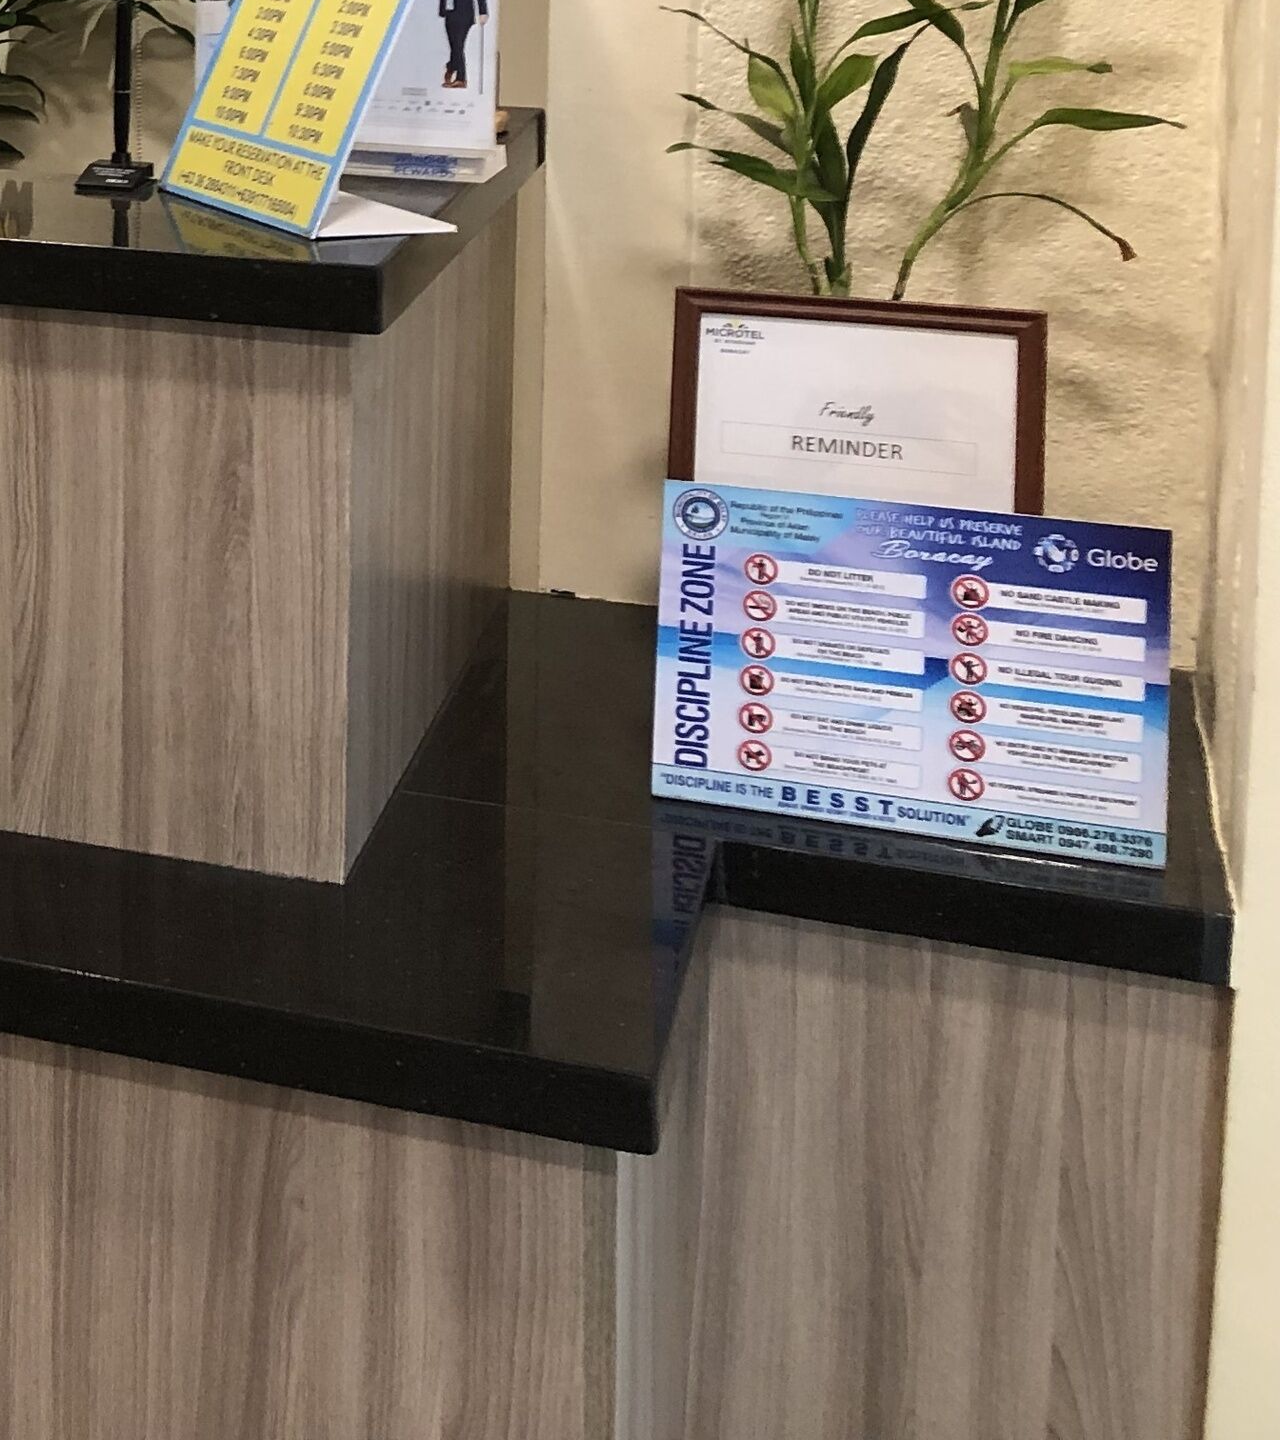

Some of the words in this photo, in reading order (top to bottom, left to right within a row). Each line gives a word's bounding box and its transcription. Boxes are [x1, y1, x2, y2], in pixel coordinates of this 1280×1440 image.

[705, 327, 766, 340] MICROTEL
[817, 400, 876, 427] Friendly
[790, 434, 905, 462] REMINDER
[855, 507, 900, 523] PLEASE
[903, 513, 935, 527] HELP
[940, 517, 955, 530] US
[960, 519, 1024, 537] PRESERVE
[889, 526, 967, 545] BEAUTIFUL
[971, 534, 1022, 552] ISLAND
[871, 539, 995, 572] Boracay
[1087, 548, 1159, 573] Globe
[680, 543, 716, 616] ZONE
[808, 568, 822, 577] DO
[824, 570, 841, 579] NOT
[844, 572, 874, 583] LITTER
[1001, 589, 1015, 598] NO
[1017, 591, 1043, 601] SAND
[1044, 594, 1083, 606] CASTLE
[1083, 598, 1121, 610] MAKING
[1015, 629, 1030, 638] NO
[1054, 633, 1099, 646] DANCING
[997, 665, 1013, 674] NO
[1014, 667, 1052, 680] ILLEGAL
[674, 619, 713, 768] DISCIPLINE
[735, 783, 747, 795] IS
[750, 784, 774, 799] THE
[1006, 817, 1054, 833] GLOBE
[1006, 829, 1055, 845] SMART
